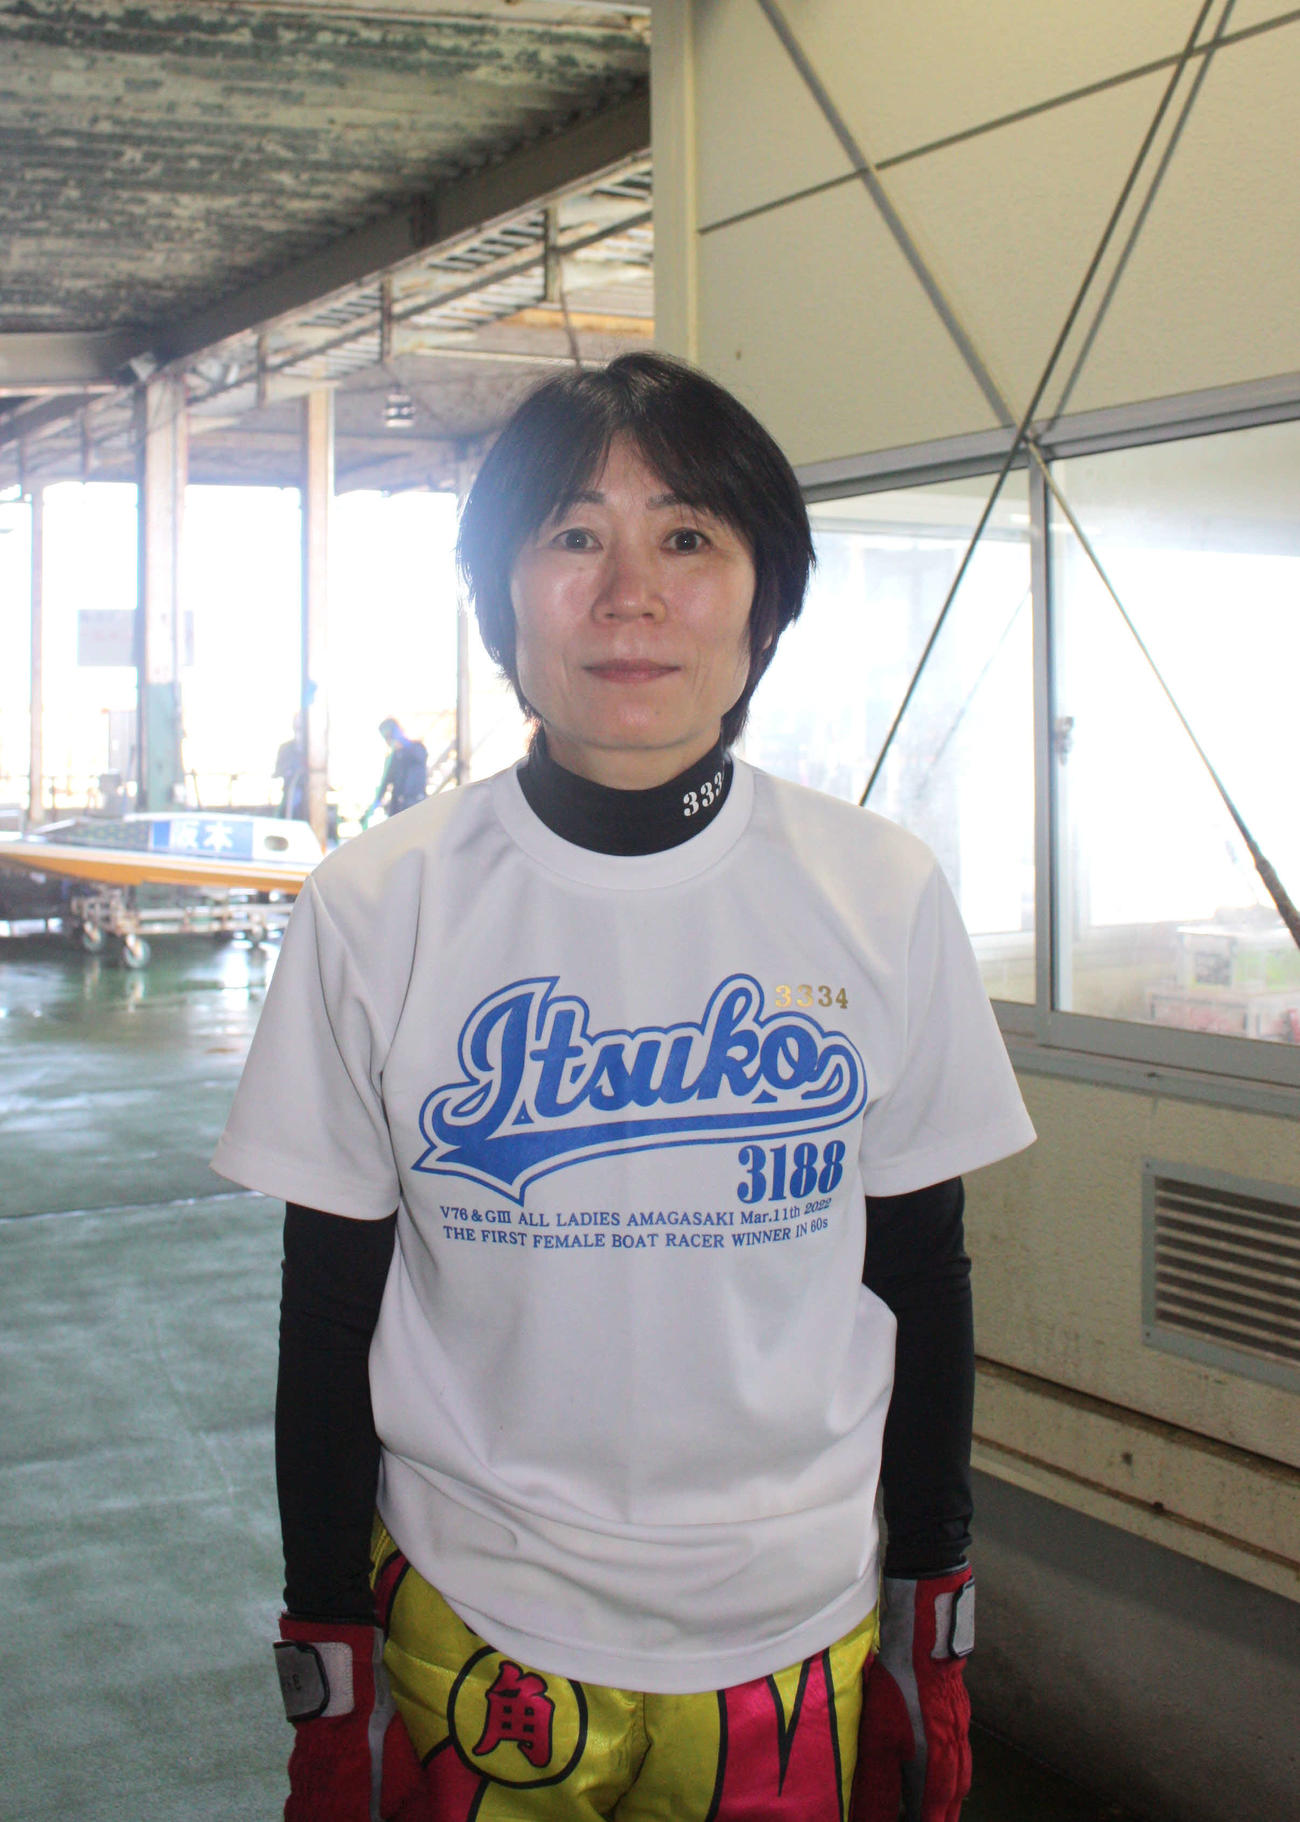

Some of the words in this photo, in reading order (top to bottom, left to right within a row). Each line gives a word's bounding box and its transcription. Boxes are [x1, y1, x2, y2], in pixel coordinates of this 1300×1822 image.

[683, 766, 724, 817] 333
[775, 984, 848, 1009] 3334
[424, 978, 862, 1148] Itsuko
[737, 1140, 846, 1205] 3188
[518, 1212, 550, 1227] ALL
[556, 1212, 620, 1227] LADIES
[627, 1211, 734, 1226] AMAGASAKI
[804, 1197, 832, 1215] 2022
[443, 1225, 476, 1241] THE
[481, 1229, 527, 1246] FIRST
[533, 1234, 605, 1249] FEMALE
[611, 1233, 658, 1248] BOAT
[665, 1233, 724, 1248] RACER
[732, 1228, 791, 1247] WINNER
[796, 1222, 808, 1238] IN
[810, 1217, 828, 1234] 60s
